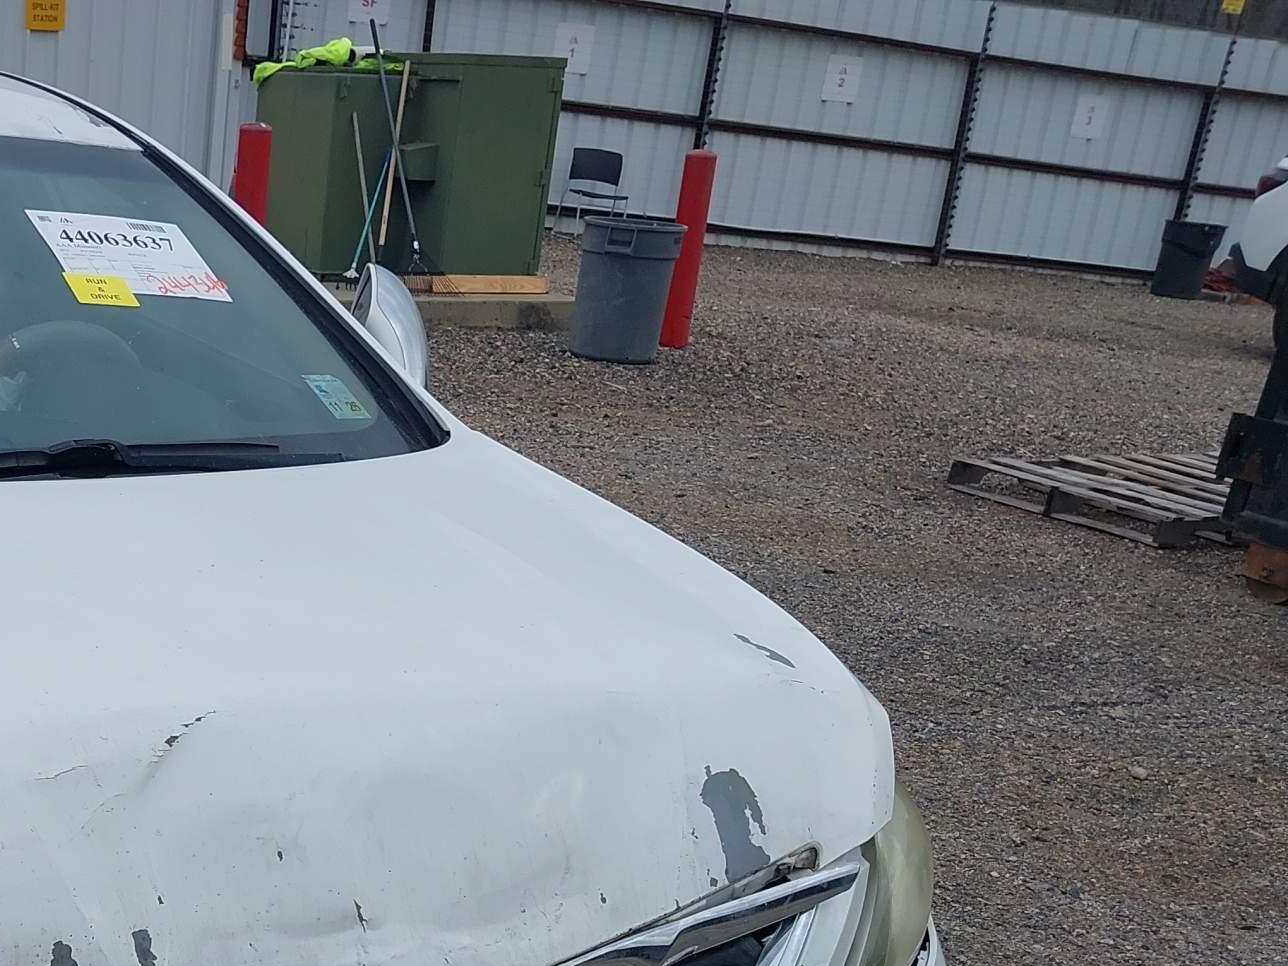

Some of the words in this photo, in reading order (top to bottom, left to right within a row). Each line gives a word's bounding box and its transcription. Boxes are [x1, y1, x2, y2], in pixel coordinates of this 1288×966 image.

[838, 77, 846, 88] 2
[59, 228, 174, 252] 44063637
[85, 278, 107, 286] RUN
[90, 293, 121, 301] DRIVE
